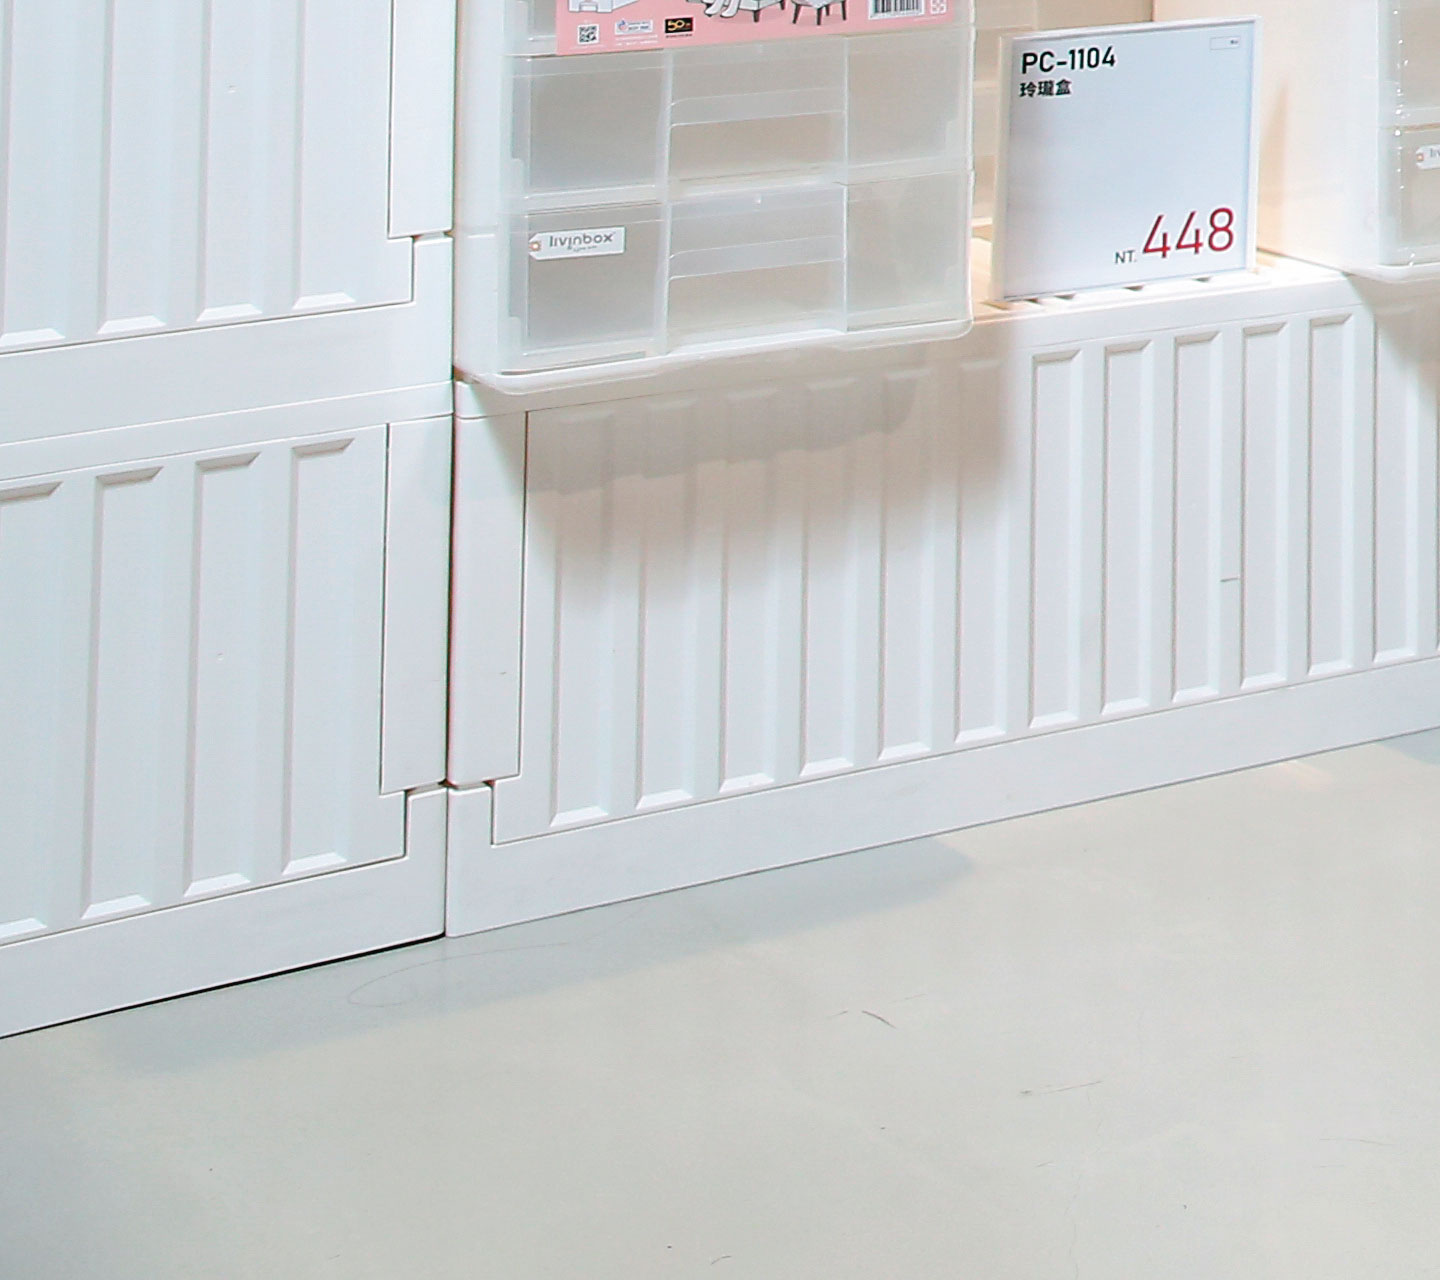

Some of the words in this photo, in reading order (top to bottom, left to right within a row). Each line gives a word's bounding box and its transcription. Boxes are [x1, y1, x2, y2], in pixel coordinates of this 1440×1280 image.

[1021, 46, 1116, 74] PC-1104
[1020, 78, 1072, 98] 玲瓏盒
[550, 233, 614, 250] livinbox
[1115, 249, 1138, 264] NT.
[1142, 207, 1235, 259] 448
